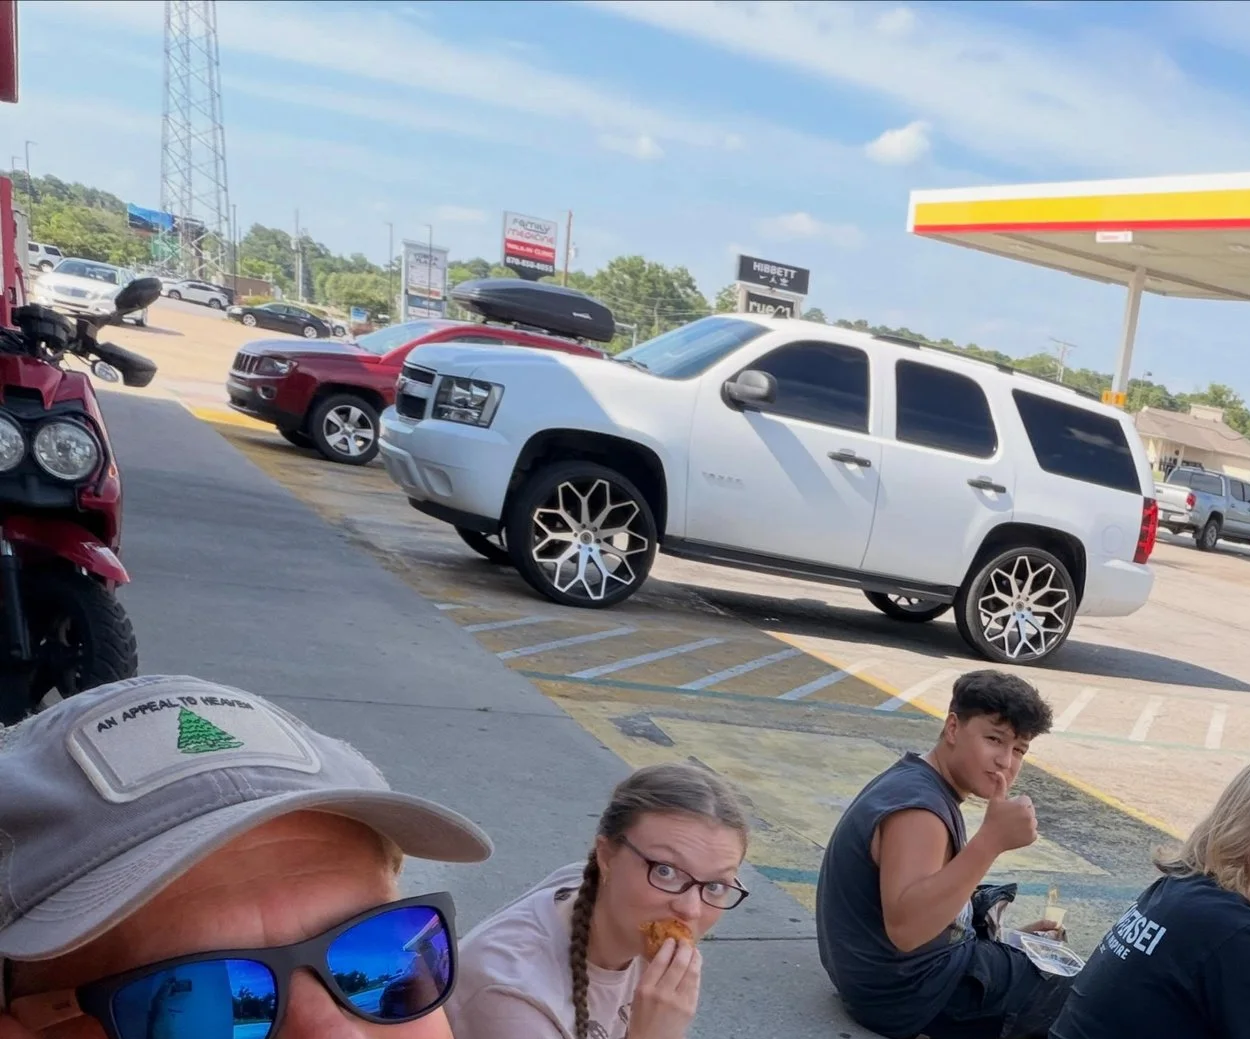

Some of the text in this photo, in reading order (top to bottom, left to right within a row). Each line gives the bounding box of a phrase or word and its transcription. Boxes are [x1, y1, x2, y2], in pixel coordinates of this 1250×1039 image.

[753, 261, 797, 278] HIBBETT
[97, 696, 254, 733] AN APPEAL TO HEAVEN
